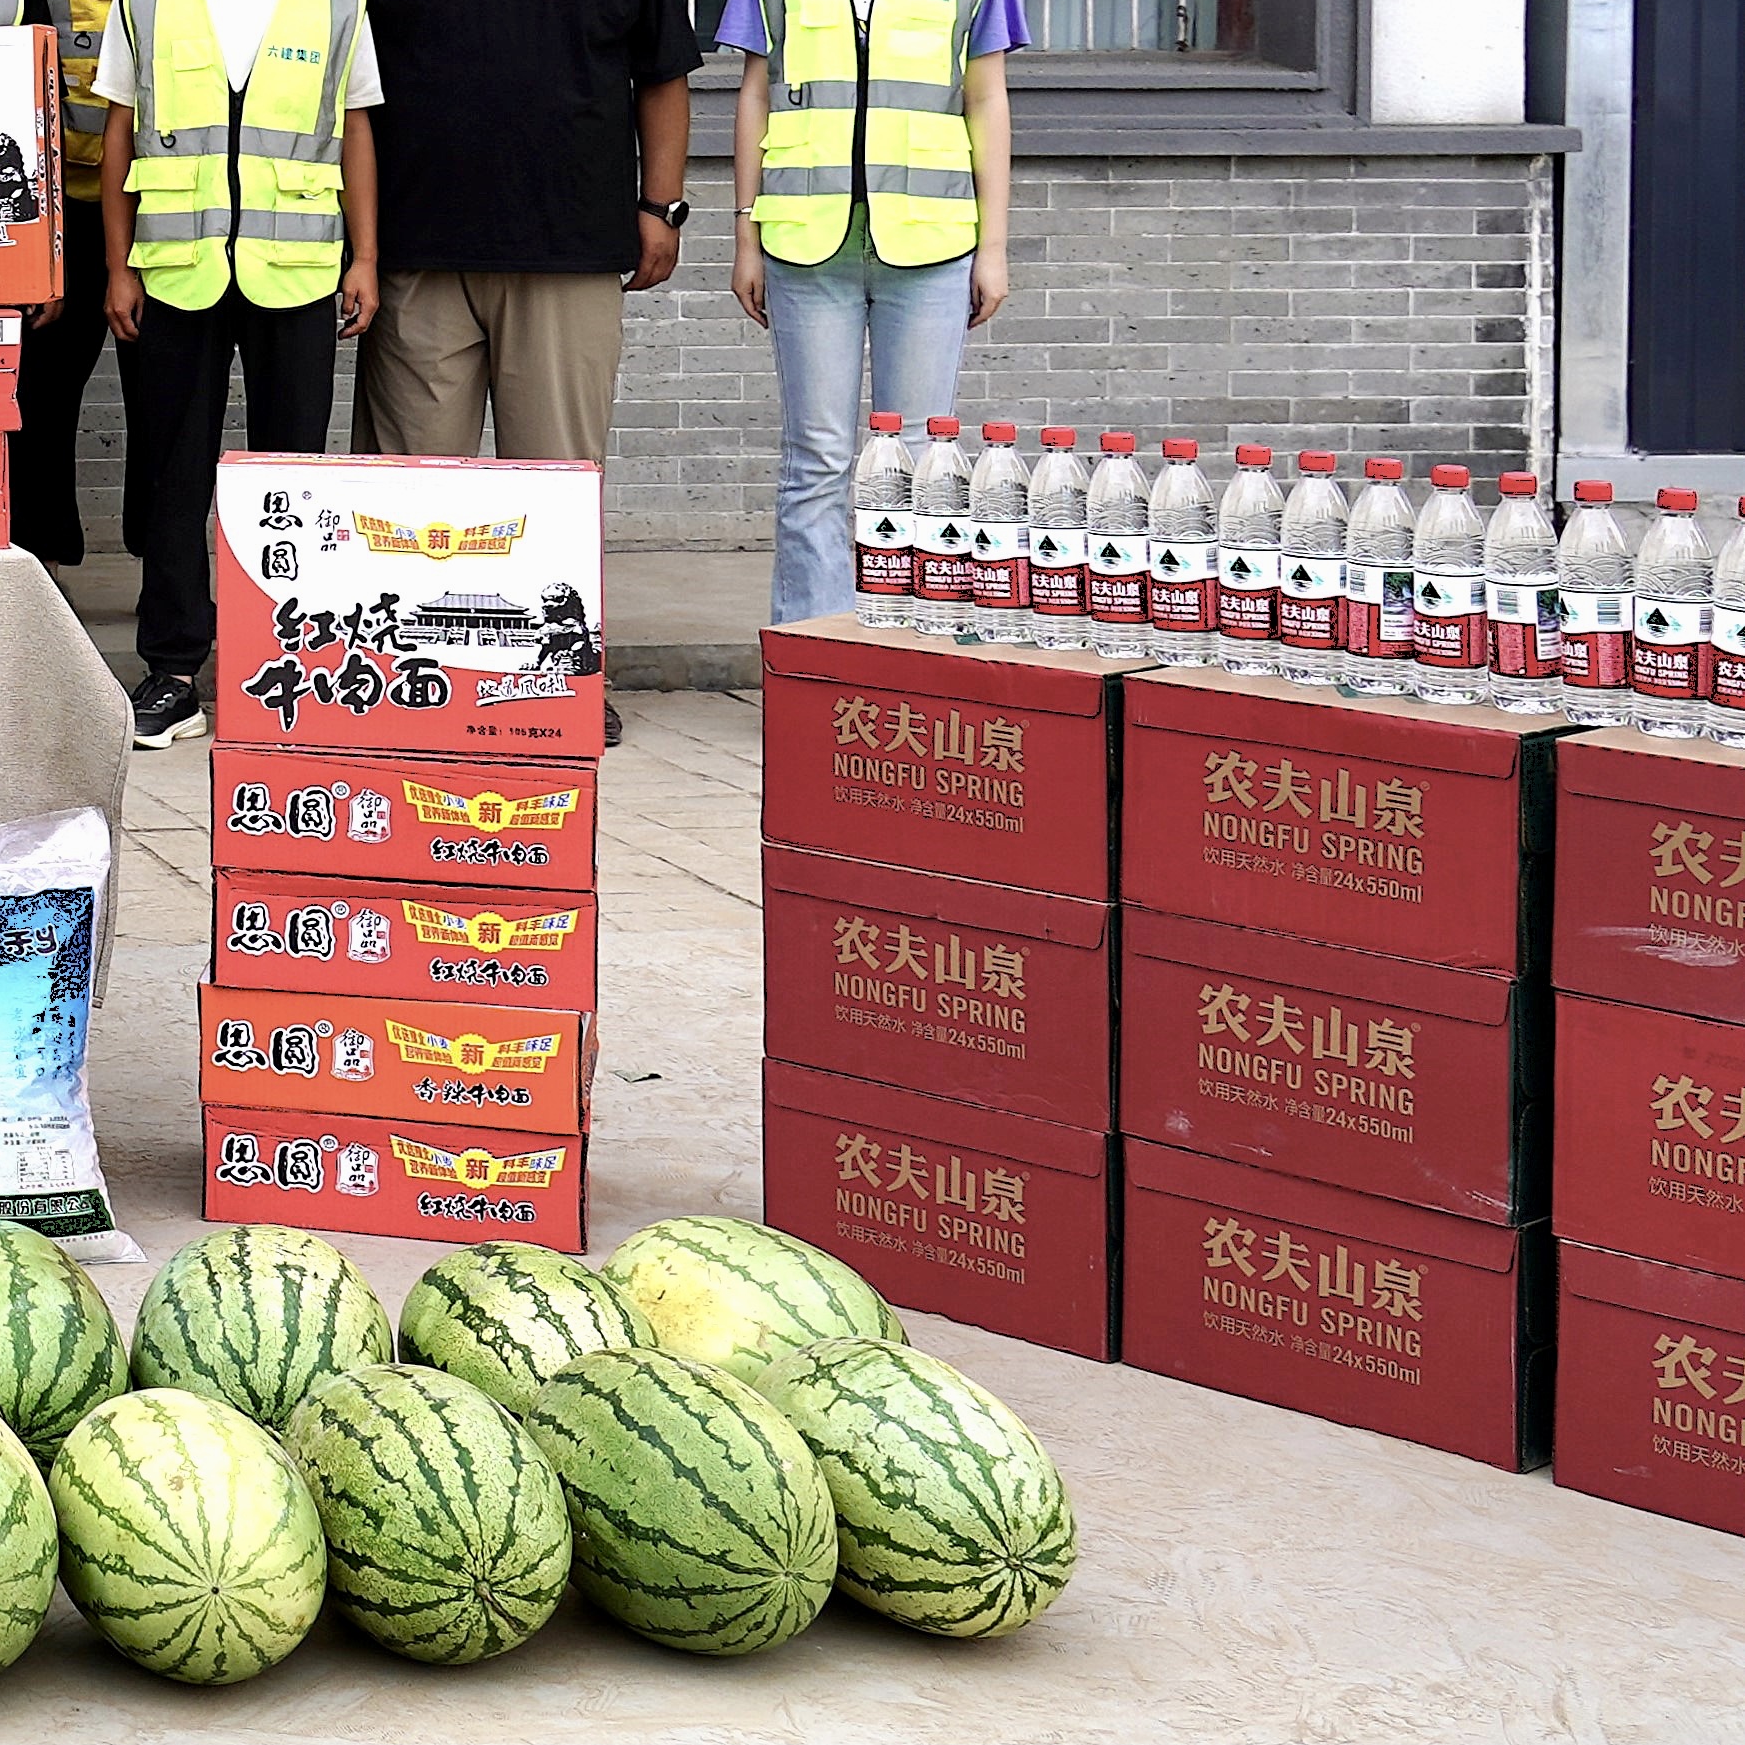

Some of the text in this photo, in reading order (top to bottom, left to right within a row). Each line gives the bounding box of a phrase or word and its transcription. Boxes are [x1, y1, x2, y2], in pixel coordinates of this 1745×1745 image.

[428, 530, 450, 550] 新
[275, 592, 418, 654] 红烧
[241, 654, 452, 732] 牛肉面
[833, 695, 1026, 773] 农夫山泉
[833, 753, 1025, 807] NONGFU SPRING
[834, 786, 905, 812] 饮用天然水
[1203, 752, 1424, 840] 农夫山泉
[478, 802, 503, 825] 新
[430, 839, 548, 866] 红烧牛肉面
[1203, 810, 1423, 875] NONGFU SPRING
[1203, 846, 1286, 877] 饮用天然水
[478, 922, 502, 946] 新
[430, 959, 547, 986] 红烧牛肉面
[833, 915, 1027, 1000] 农夫山泉
[835, 972, 1027, 1034] NONGFU SPRING
[835, 1004, 906, 1033] 饮用天然水
[1197, 982, 1416, 1081] 农夫山泉
[461, 1043, 485, 1067] 新
[415, 1077, 531, 1106] 香辣牛肉面
[1198, 1043, 1414, 1116] NONGFU SPRING
[1198, 1078, 1279, 1112] 饮用天然水
[465, 1159, 489, 1182] 新
[835, 1132, 1027, 1225] 农夫山泉
[418, 1193, 535, 1223] 红烧牛肉面
[836, 1189, 1026, 1258] NONGFU SPRING
[837, 1221, 907, 1253] 饮用天然水
[1202, 1215, 1423, 1322] 农夫山泉
[1203, 1276, 1421, 1358] NONGFU SPRING
[1203, 1311, 1285, 1349] 饮用天然水
